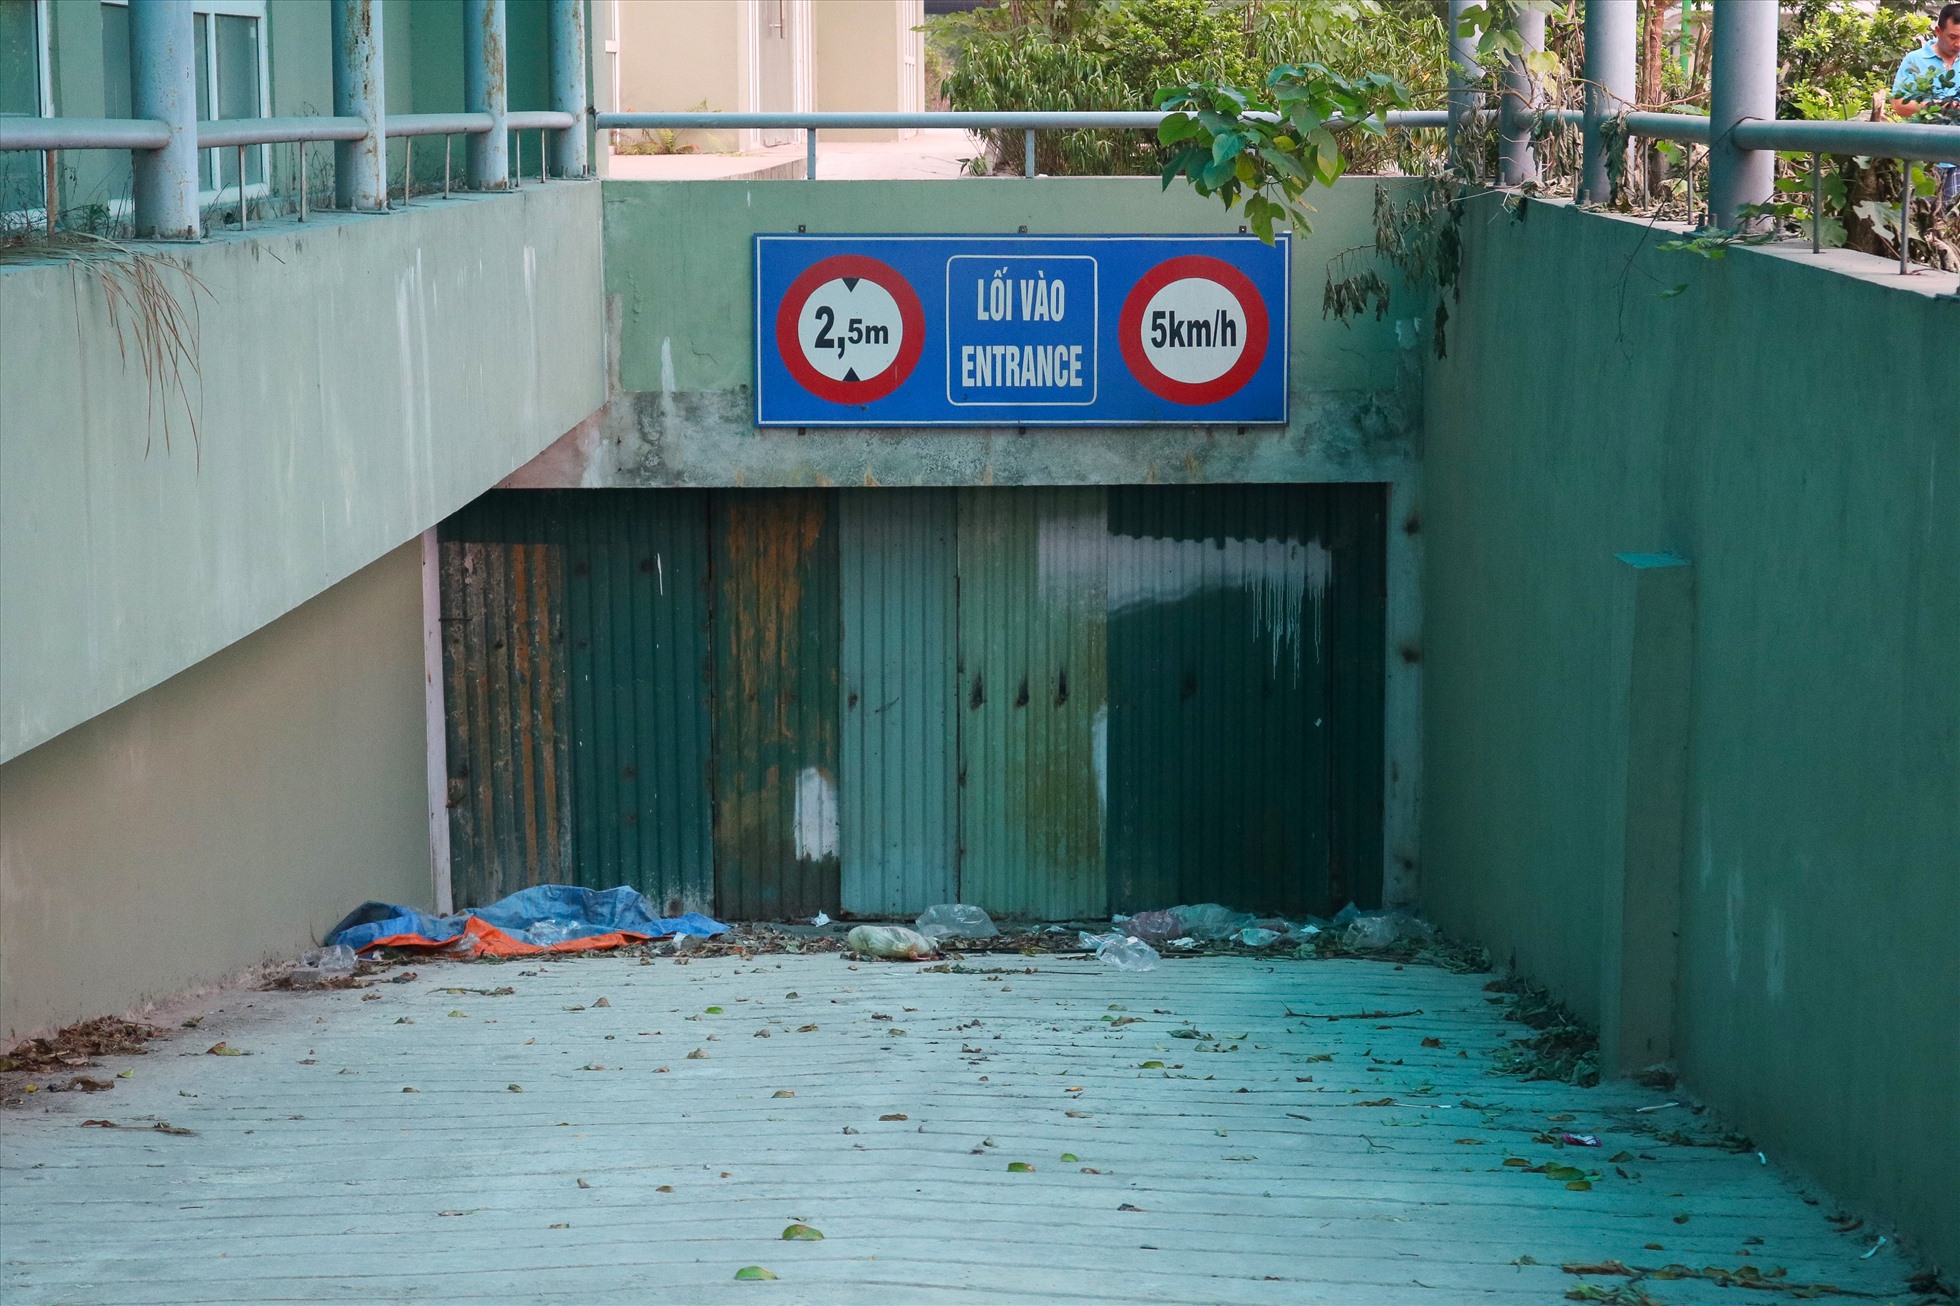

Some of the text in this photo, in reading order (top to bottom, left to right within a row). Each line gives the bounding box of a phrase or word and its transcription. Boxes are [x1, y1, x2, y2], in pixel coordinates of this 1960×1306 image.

[976, 266, 1065, 322] LỐI VÀO
[815, 306, 889, 359] 2,5m
[1150, 309, 1237, 348] 5km/h
[961, 344, 1083, 388] ENTRANCE
